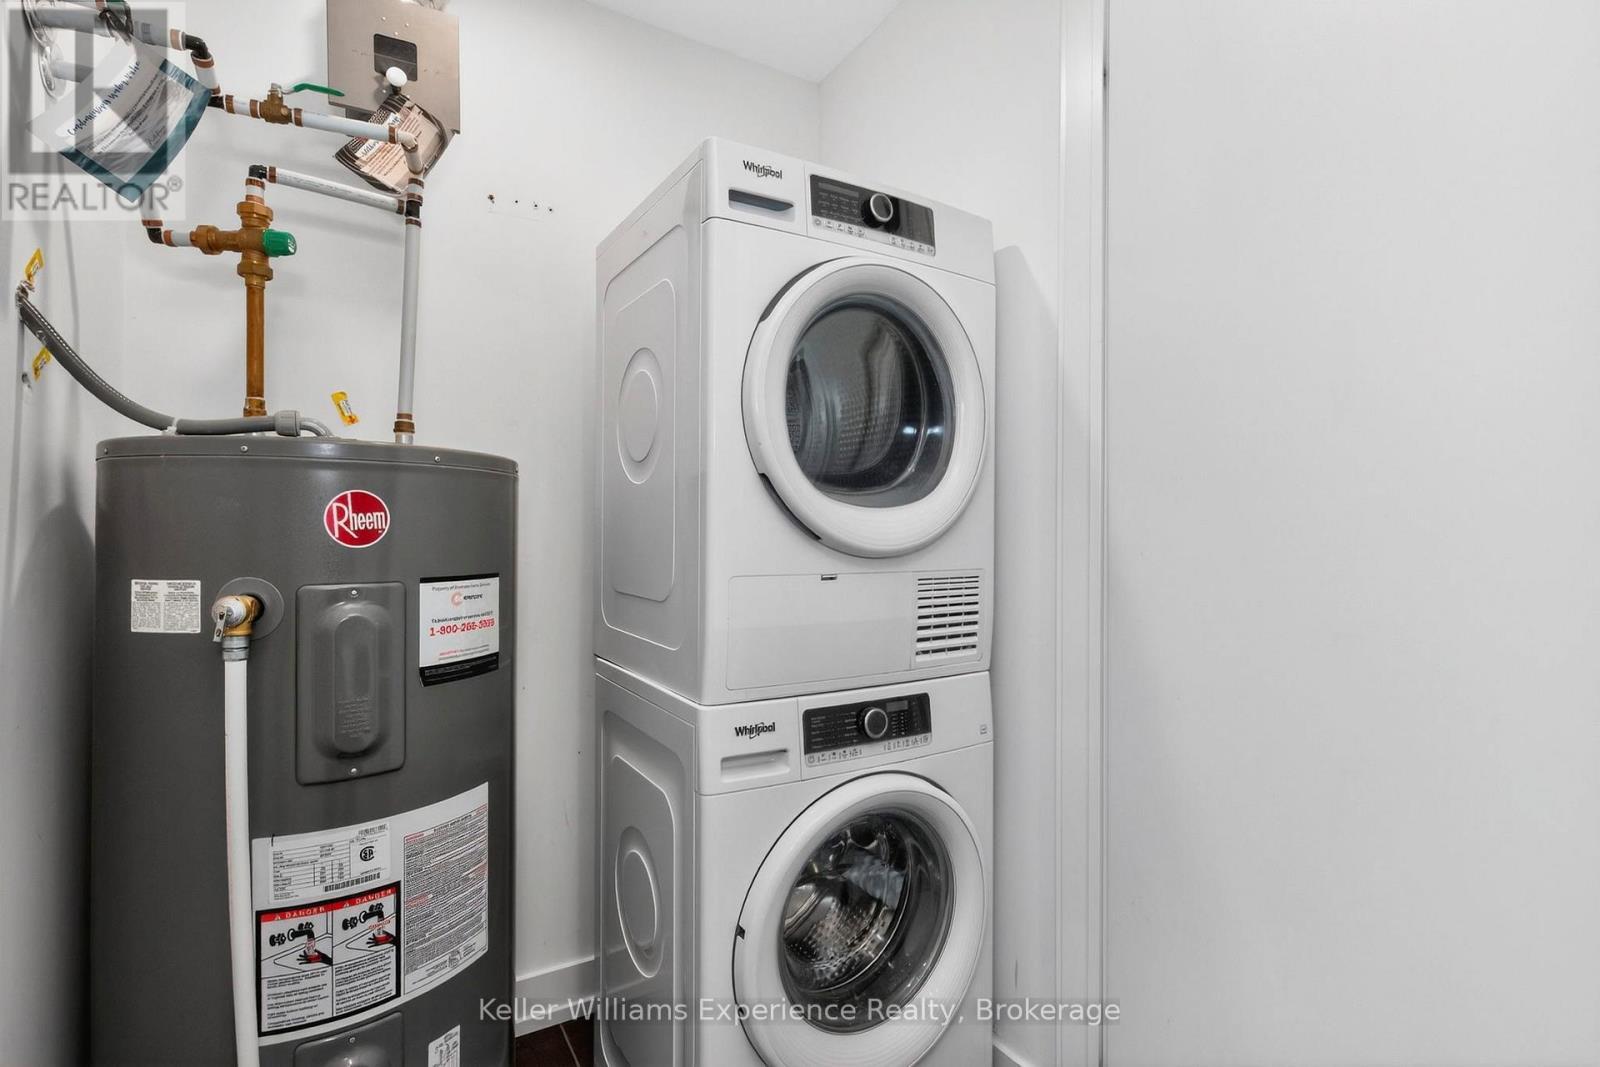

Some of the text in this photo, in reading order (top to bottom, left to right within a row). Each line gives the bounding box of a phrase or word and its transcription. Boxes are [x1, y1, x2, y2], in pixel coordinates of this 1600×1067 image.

[742, 159, 783, 180] Whirlpool
[332, 491, 386, 539] Rheem
[734, 721, 776, 739] Whirlpool
[355, 888, 392, 905] DANGER
[285, 906, 326, 919] DANGER
